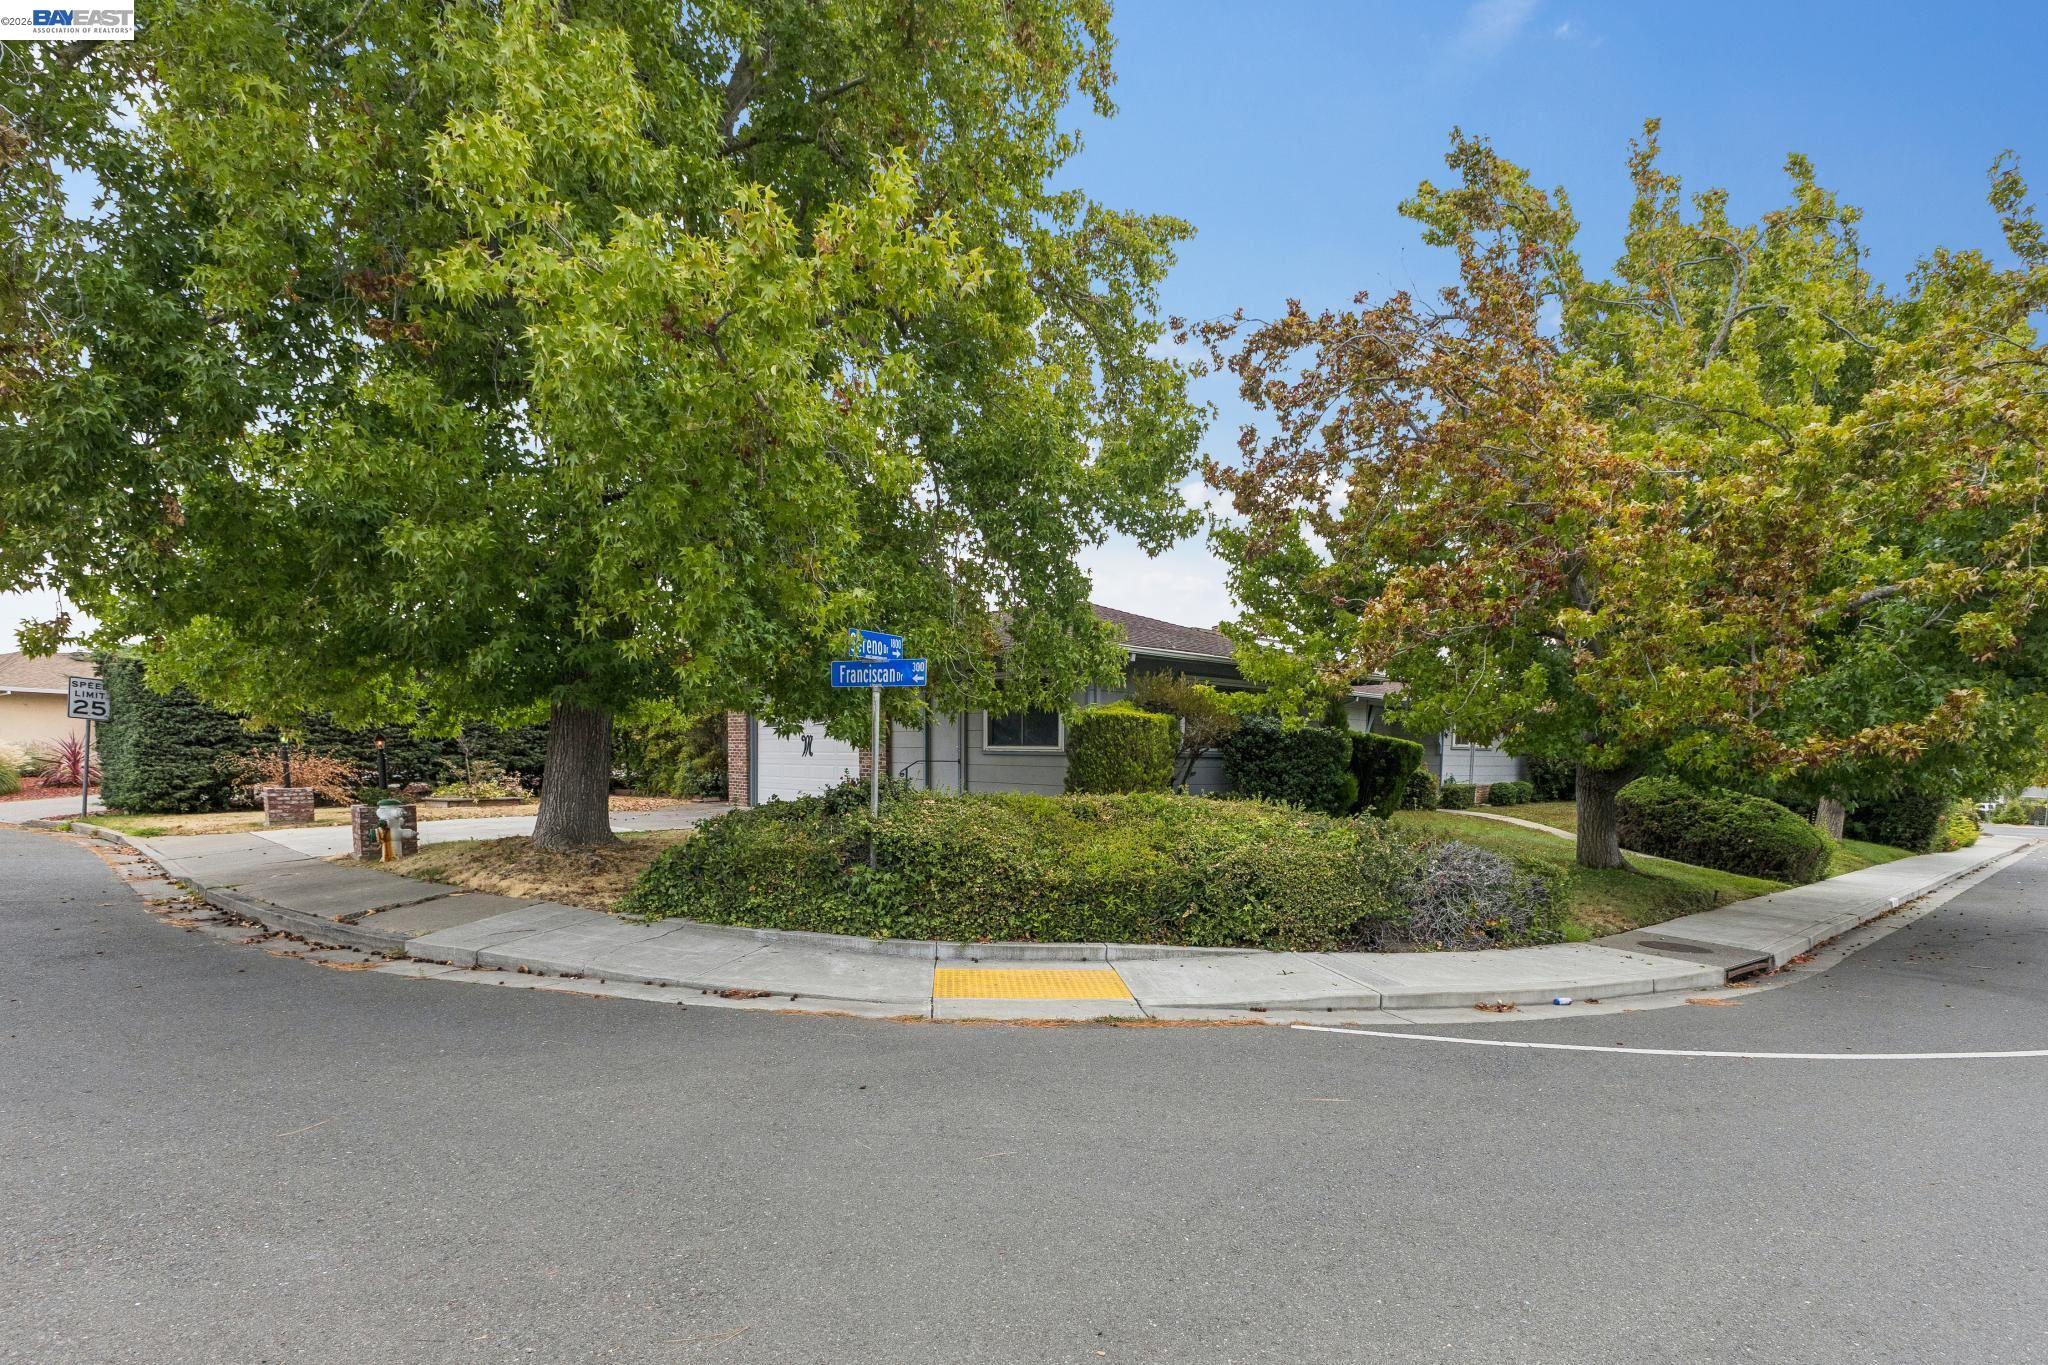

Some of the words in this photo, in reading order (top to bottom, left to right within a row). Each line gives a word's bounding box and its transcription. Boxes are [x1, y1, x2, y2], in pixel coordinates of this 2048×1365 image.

[890, 638, 902, 650] 1800
[840, 664, 895, 683] Franciscan
[896, 671, 904, 682] Dr
[912, 662, 925, 673] 300
[74, 690, 106, 700] LIMIT
[73, 699, 107, 716] 25
